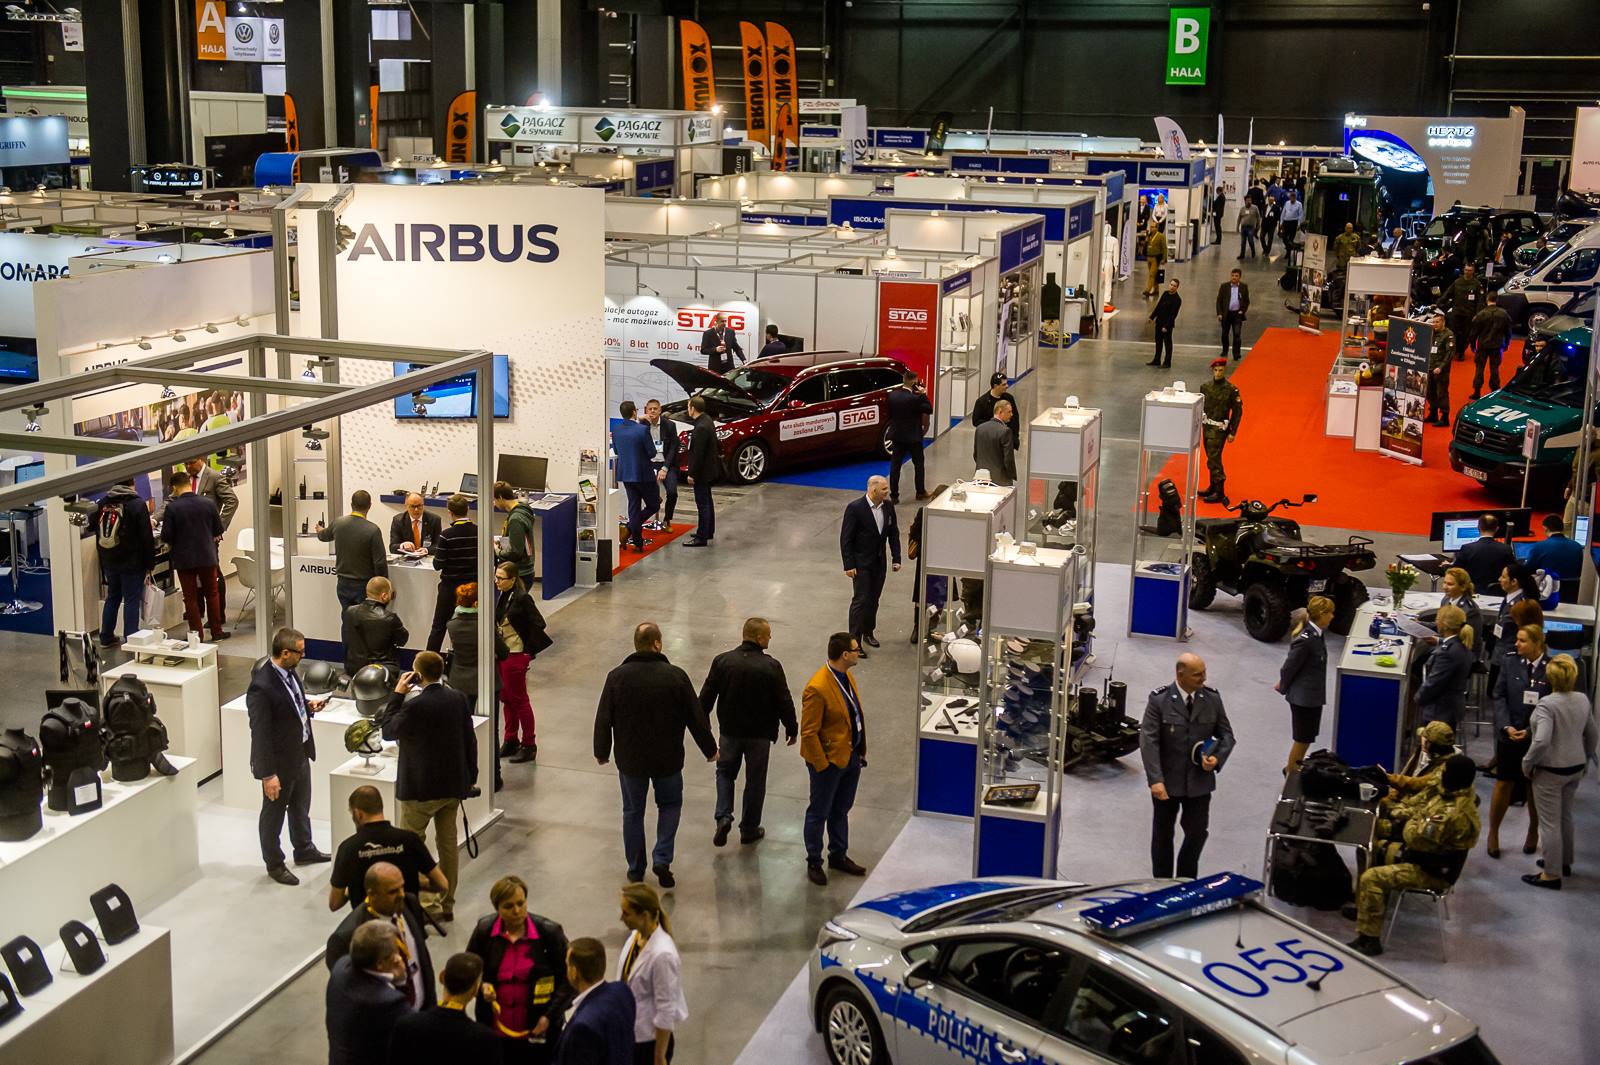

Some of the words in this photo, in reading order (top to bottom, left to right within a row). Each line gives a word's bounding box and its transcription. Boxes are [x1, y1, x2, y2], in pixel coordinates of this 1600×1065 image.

[199, 1, 225, 33] A
[1175, 17, 1200, 54] B
[201, 44, 225, 53] HALA
[1170, 67, 1202, 77] HALA
[522, 116, 566, 128] PAGACZ
[617, 120, 662, 132] PAGACZ
[528, 128, 564, 137] SYNOWIE
[624, 132, 660, 140] SYNOWIE
[1428, 127, 1475, 136] HERTZ
[347, 223, 560, 264] AIRBUS
[626, 308, 659, 317] autogaz
[888, 310, 928, 321] STAG
[630, 318, 674, 327] możliwości
[630, 340, 636, 348] 8
[637, 339, 649, 349] lat
[656, 341, 680, 350] 1000
[687, 343, 693, 351] 4
[842, 410, 876, 425] STAG
[1477, 404, 1530, 423] ZW
[300, 564, 337, 576] AIRBUS
[1202, 939, 1344, 998] 055
[928, 1008, 992, 1063] POLICJA
